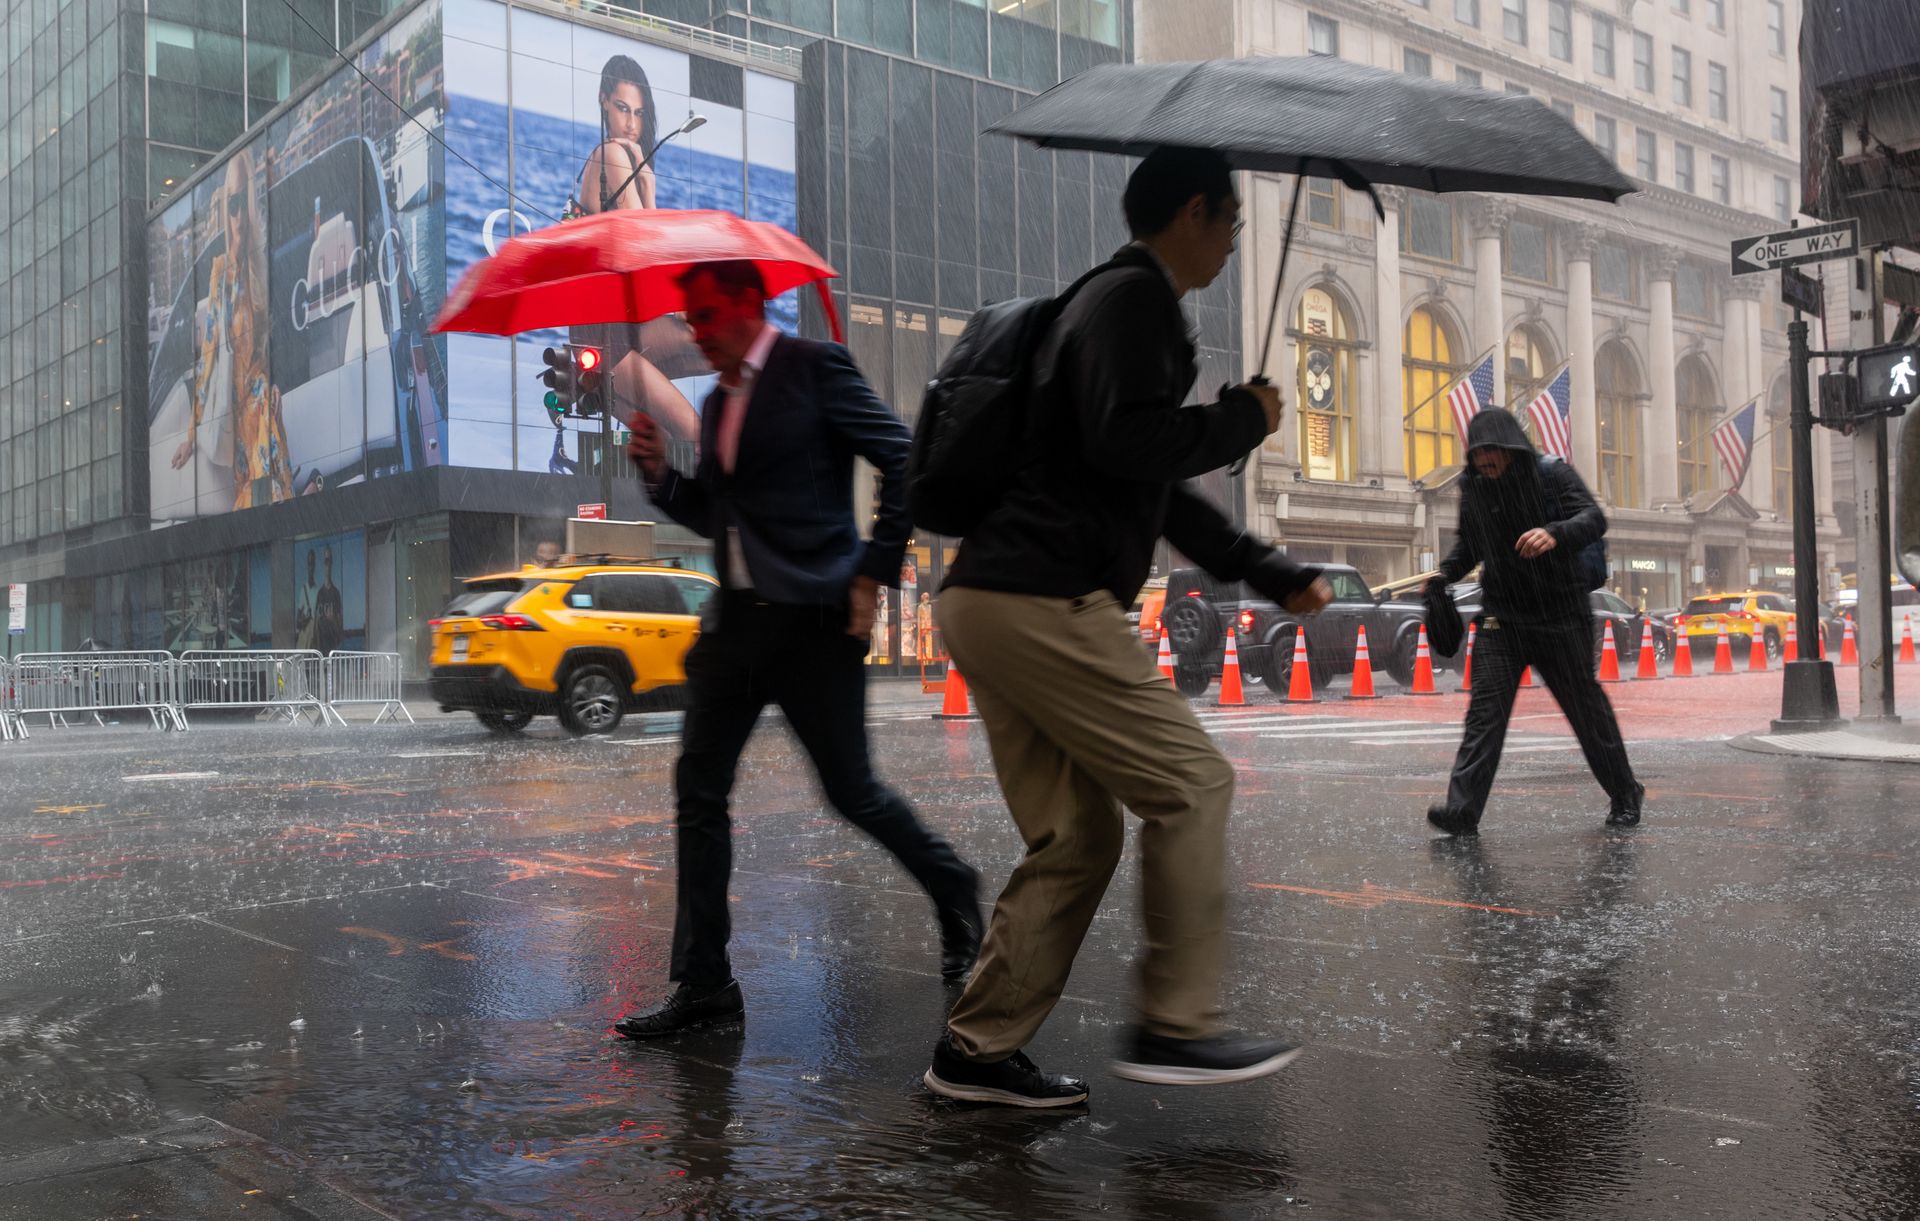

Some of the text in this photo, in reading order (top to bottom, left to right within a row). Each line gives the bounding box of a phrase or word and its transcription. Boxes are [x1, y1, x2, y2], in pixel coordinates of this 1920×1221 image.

[1755, 233, 1844, 261] ONE WAY
[292, 216, 417, 331] GUCCI
[1632, 560, 1656, 570] MANGO
